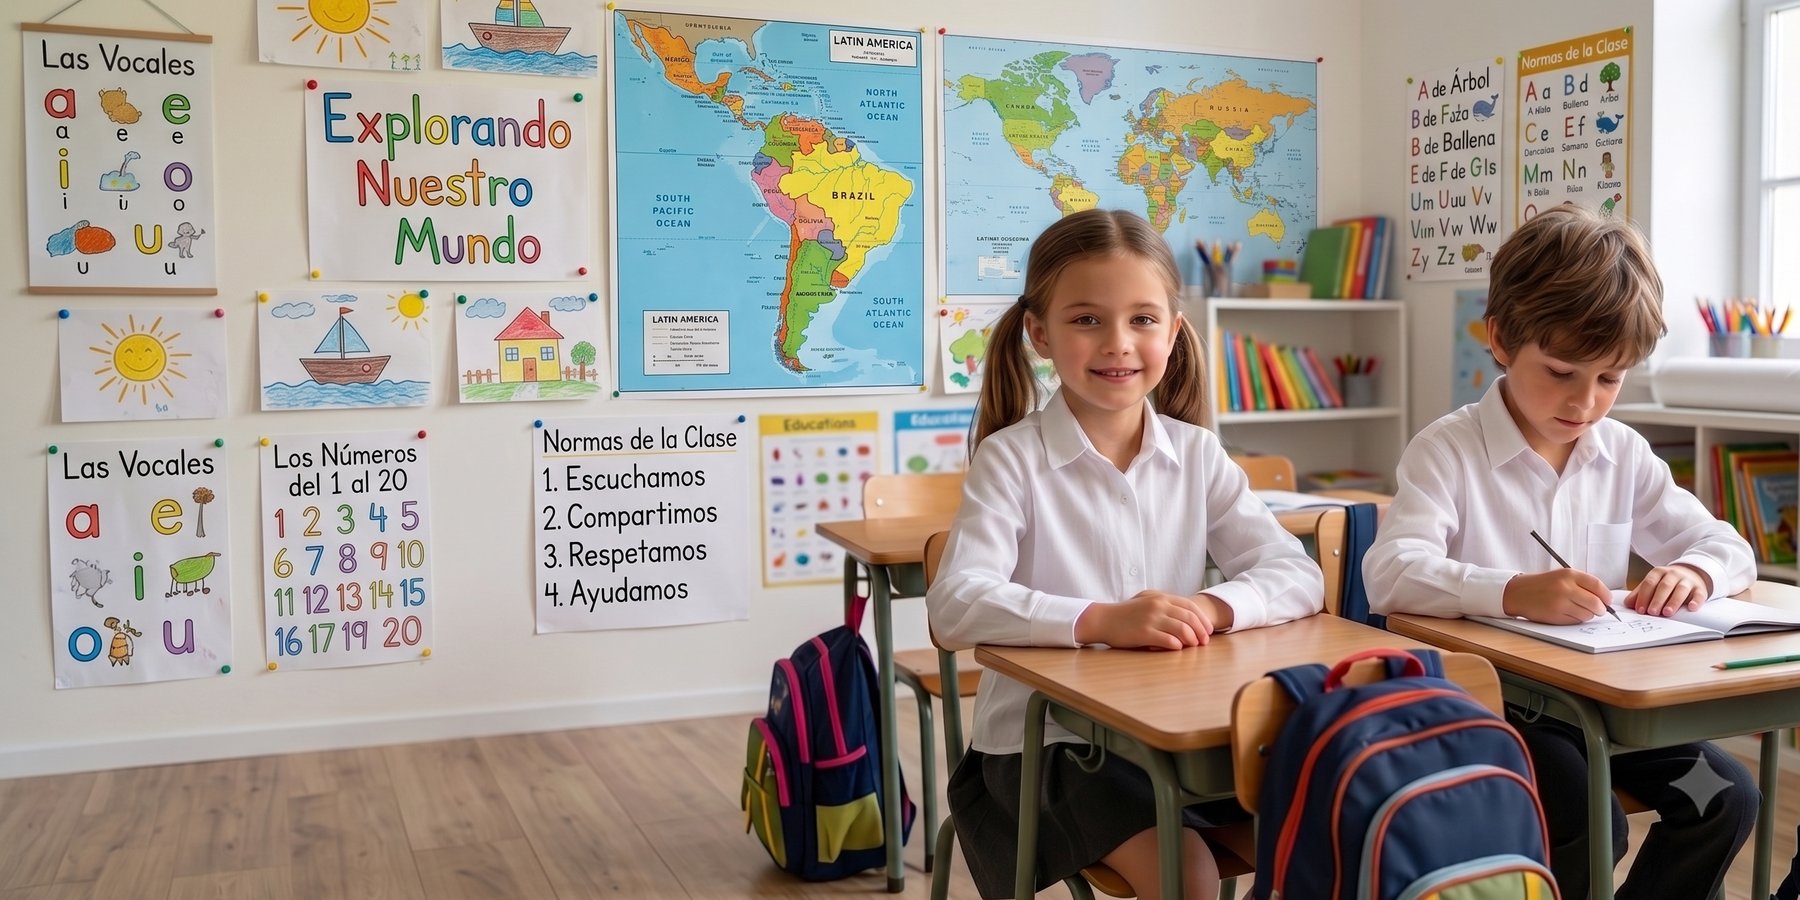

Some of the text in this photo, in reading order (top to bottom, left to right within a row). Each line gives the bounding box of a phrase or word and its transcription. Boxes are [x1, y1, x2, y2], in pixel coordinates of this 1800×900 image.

[42, 39, 196, 76] Las Vocales
[833, 35, 864, 47] LATIN
[866, 37, 914, 51] AMERICA
[1521, 38, 1628, 70] Normas de la Clase
[865, 88, 898, 98] NORTH
[1417, 66, 1490, 101] A de Árbol
[44, 88, 191, 125] a e
[859, 100, 905, 110] ATLANTIC
[866, 112, 899, 122] OCEAN
[1209, 104, 1250, 113] RUSSIA
[1411, 109, 1421, 129] B
[1423, 108, 1437, 128] de
[56, 125, 184, 145] a e e
[323, 92, 572, 162] Explorando
[1411, 129, 1496, 157] B de Ballena
[58, 147, 194, 193] i o
[357, 158, 533, 207] Nuestro
[1411, 164, 1419, 185] E
[1421, 165, 1436, 183] de
[1440, 161, 1448, 182] F
[1450, 161, 1466, 180] de
[62, 193, 68, 210] i
[173, 198, 186, 212] o
[656, 194, 691, 203] SOUTH
[831, 191, 875, 201] BRAZIL
[652, 206, 694, 216] PACIFIC
[656, 219, 691, 228] OCEAN
[394, 214, 542, 266] Mundo
[164, 262, 177, 276] u
[865, 309, 912, 318] ATLANTIC
[872, 297, 904, 306] SOUTH
[652, 315, 719, 324] LATIN AMERICA
[872, 320, 904, 329] OCEAN
[543, 424, 738, 453] Normas de la Clase
[63, 448, 215, 480] Las Vocales
[274, 441, 418, 469] Los Números
[289, 468, 408, 497] del 1 al 20
[542, 463, 706, 492] 1. Escuchamos
[65, 498, 183, 540] a e
[274, 500, 420, 539] 1 2 3 4 5
[543, 501, 718, 534] 2. Compartimos
[273, 539, 425, 579] 6 7 8 9 10
[543, 539, 708, 573] 3. Respetamos
[133, 551, 145, 602] i
[273, 577, 426, 617] 11 12 13 14 15
[544, 576, 689, 613] 4. Ayudamos
[67, 618, 195, 663] o u
[274, 615, 423, 657] 16 17 19 20
